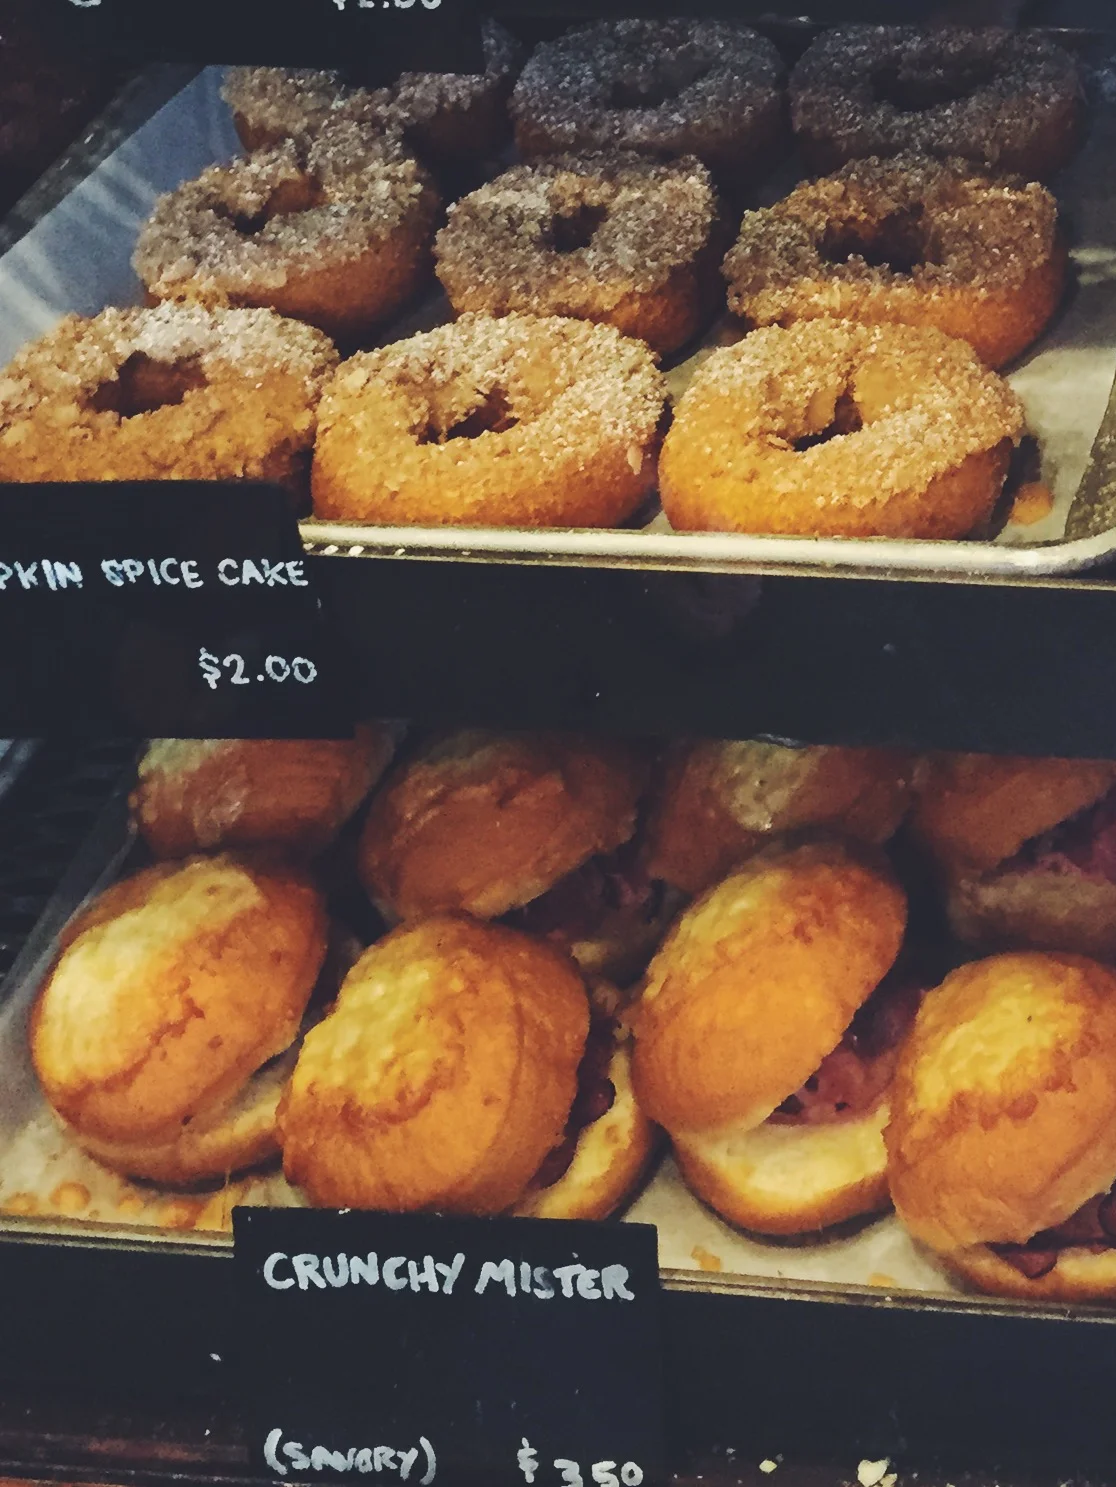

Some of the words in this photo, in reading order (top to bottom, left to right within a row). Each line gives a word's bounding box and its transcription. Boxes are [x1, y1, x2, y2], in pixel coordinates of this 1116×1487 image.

[101, 558, 204, 588] SPICE
[218, 558, 309, 587] CAKE
[199, 647, 318, 689] $2.00
[264, 1252, 466, 1294] CRUNCHY
[474, 1257, 636, 1300] MISTER
